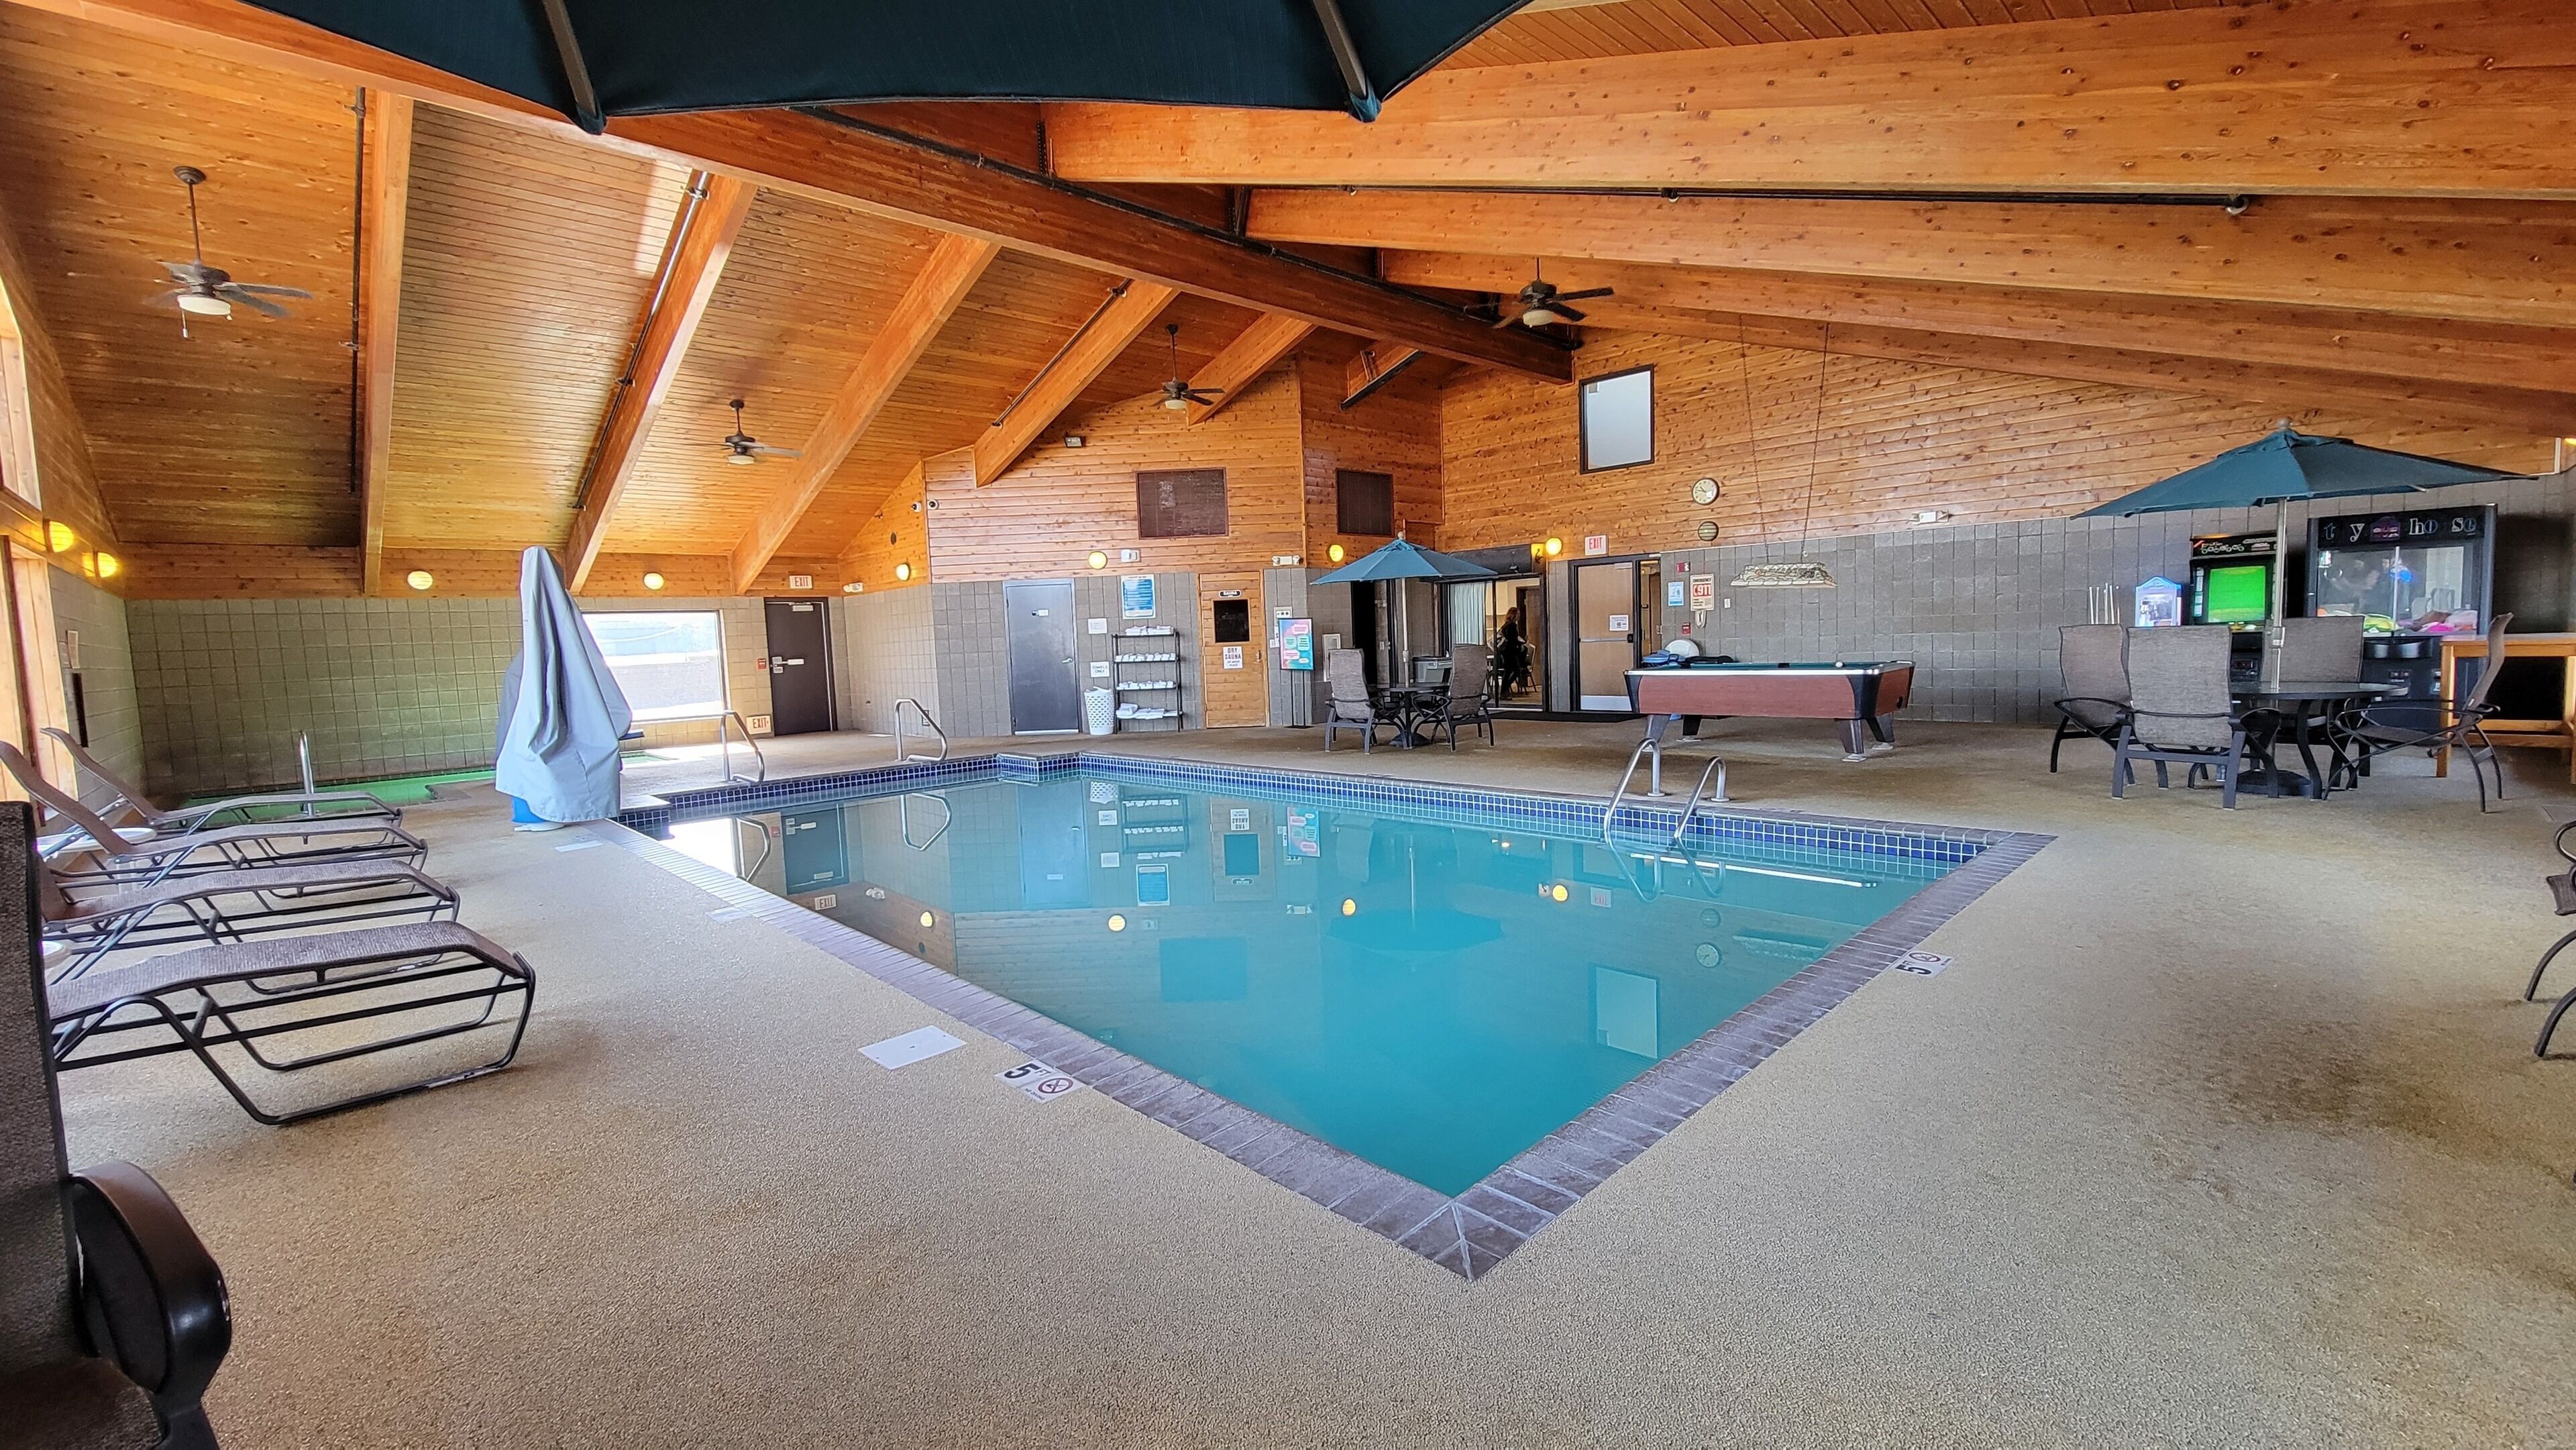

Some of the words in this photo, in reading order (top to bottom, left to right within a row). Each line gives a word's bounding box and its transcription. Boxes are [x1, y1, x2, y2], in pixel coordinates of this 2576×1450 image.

[1589, 537, 1602, 550] EXIT
[794, 577, 808, 586] EXIT
[1697, 584, 1711, 596] 911
[753, 717, 767, 728] EXIT
[1895, 964, 1931, 974] 5
[1004, 1063, 1041, 1078] 5
